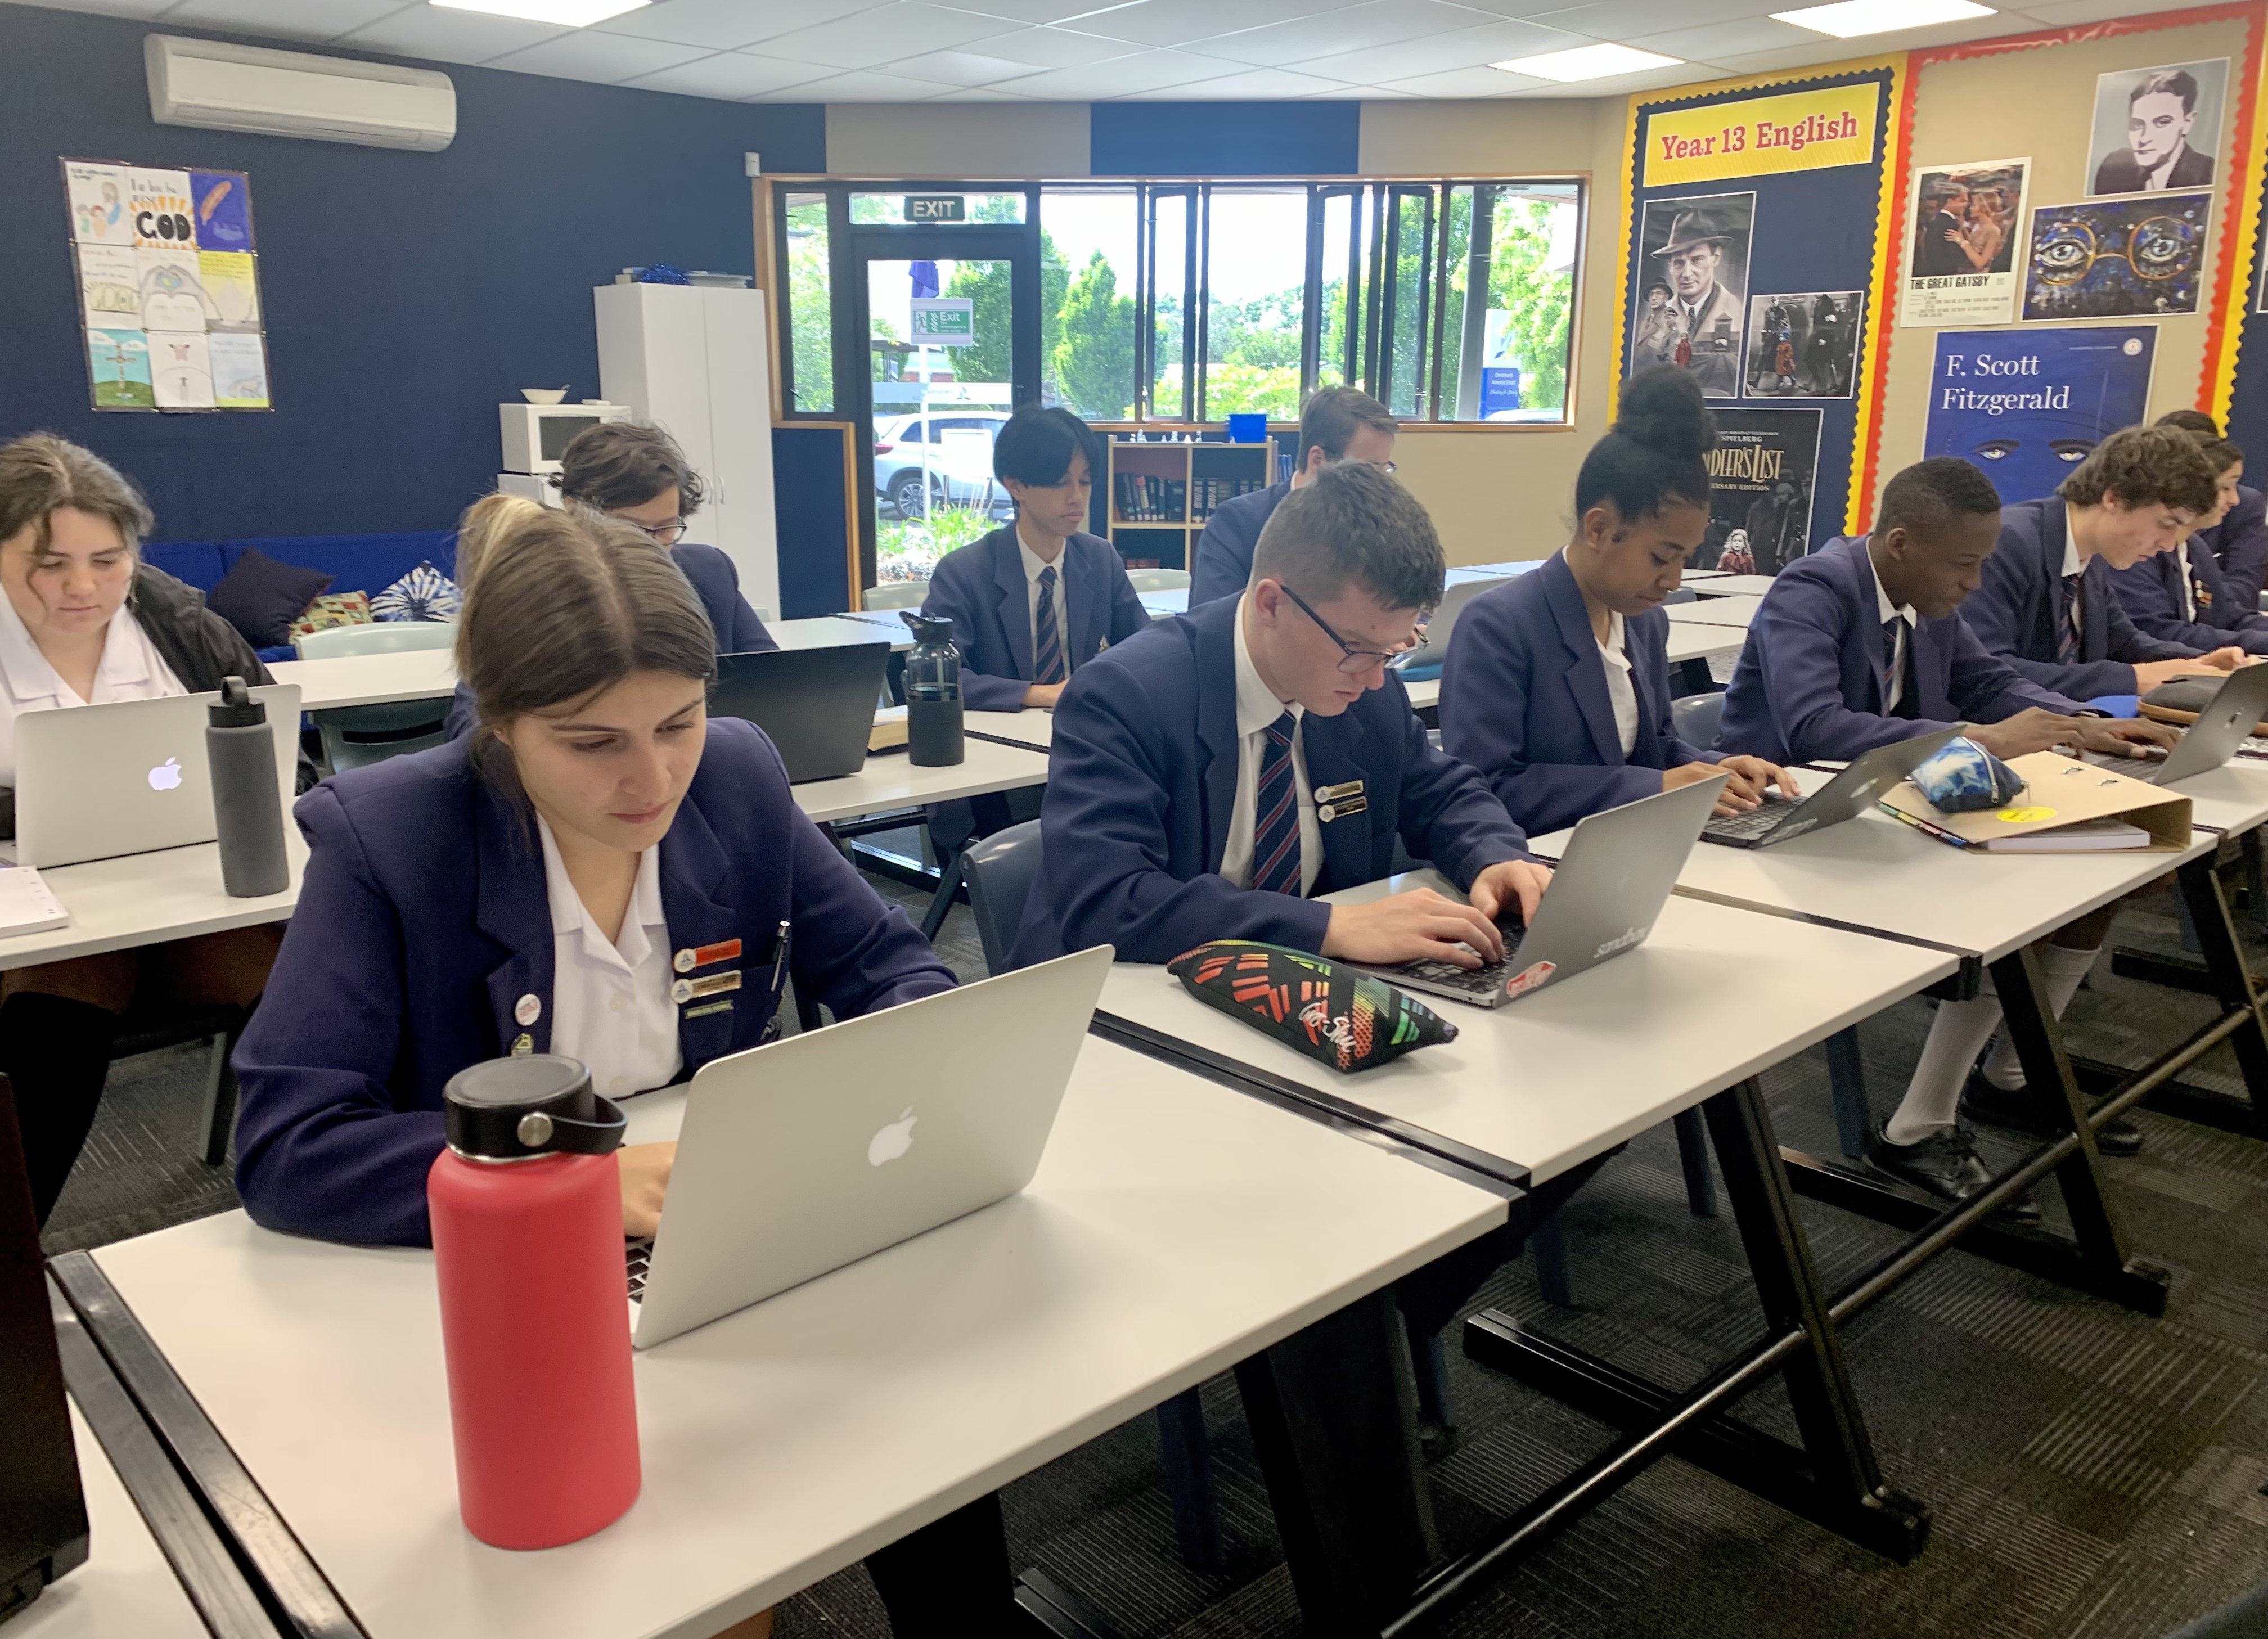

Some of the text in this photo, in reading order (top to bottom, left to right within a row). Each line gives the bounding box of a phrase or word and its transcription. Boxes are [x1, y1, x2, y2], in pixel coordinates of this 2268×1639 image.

[1662, 111, 1857, 160] Year 13 English
[913, 201, 956, 217] EXIT
[1910, 278, 1925, 290] THE
[1927, 277, 1954, 289] GREAT
[1955, 275, 1990, 287] GATSBY
[940, 312, 961, 321] Exit
[1944, 354, 2041, 377] F. Scott
[1941, 385, 2070, 416] Fitzgerald
